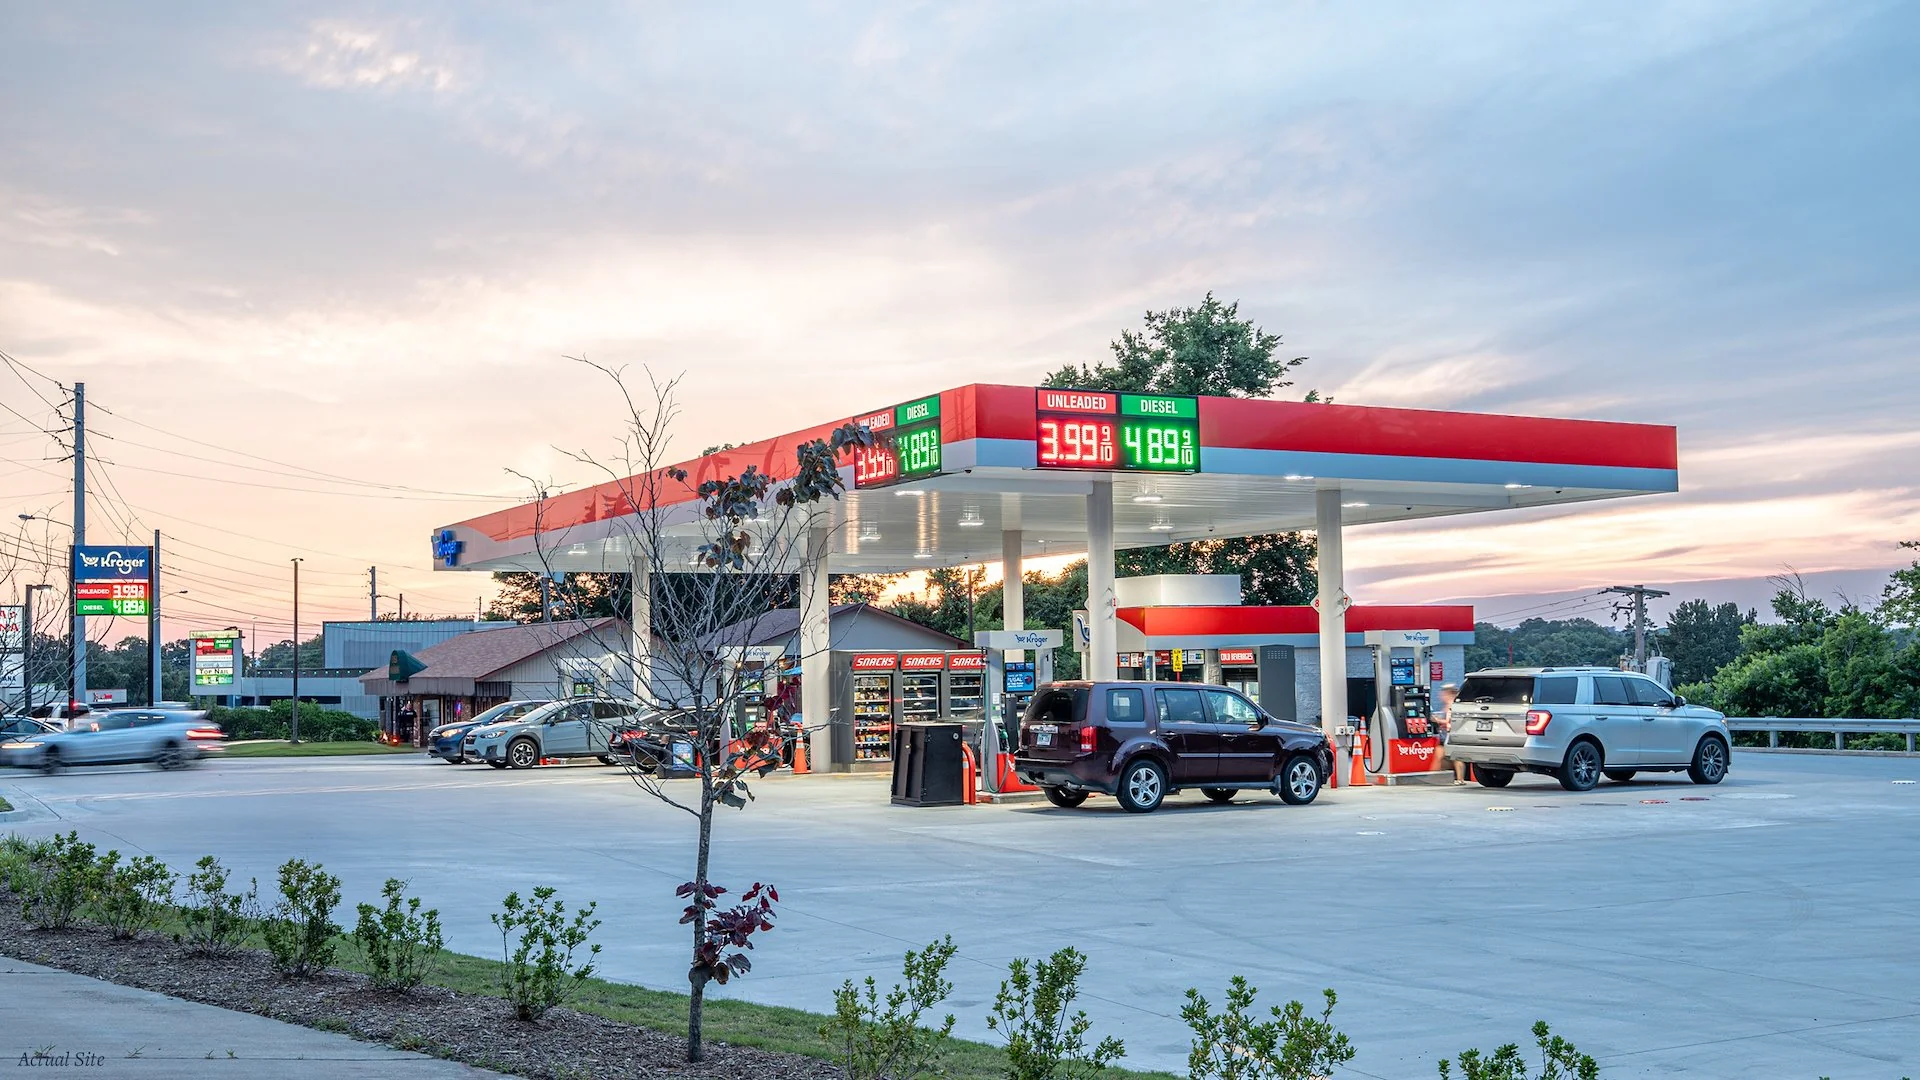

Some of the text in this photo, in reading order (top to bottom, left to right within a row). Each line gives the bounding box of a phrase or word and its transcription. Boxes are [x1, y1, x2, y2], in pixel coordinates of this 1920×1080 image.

[1047, 394, 1107, 410] UNLEADED
[1140, 399, 1179, 414] DIESEL
[906, 403, 929, 420] DIESEL
[1041, 423, 1097, 461] 3.99
[100, 551, 145, 574] Kroger
[1315, 599, 1319, 607] 8
[1026, 632, 1048, 647] Kroger
[856, 657, 894, 667] SNACKS
[905, 656, 942, 666] SNACKS
[1409, 741, 1434, 760] Kroger
